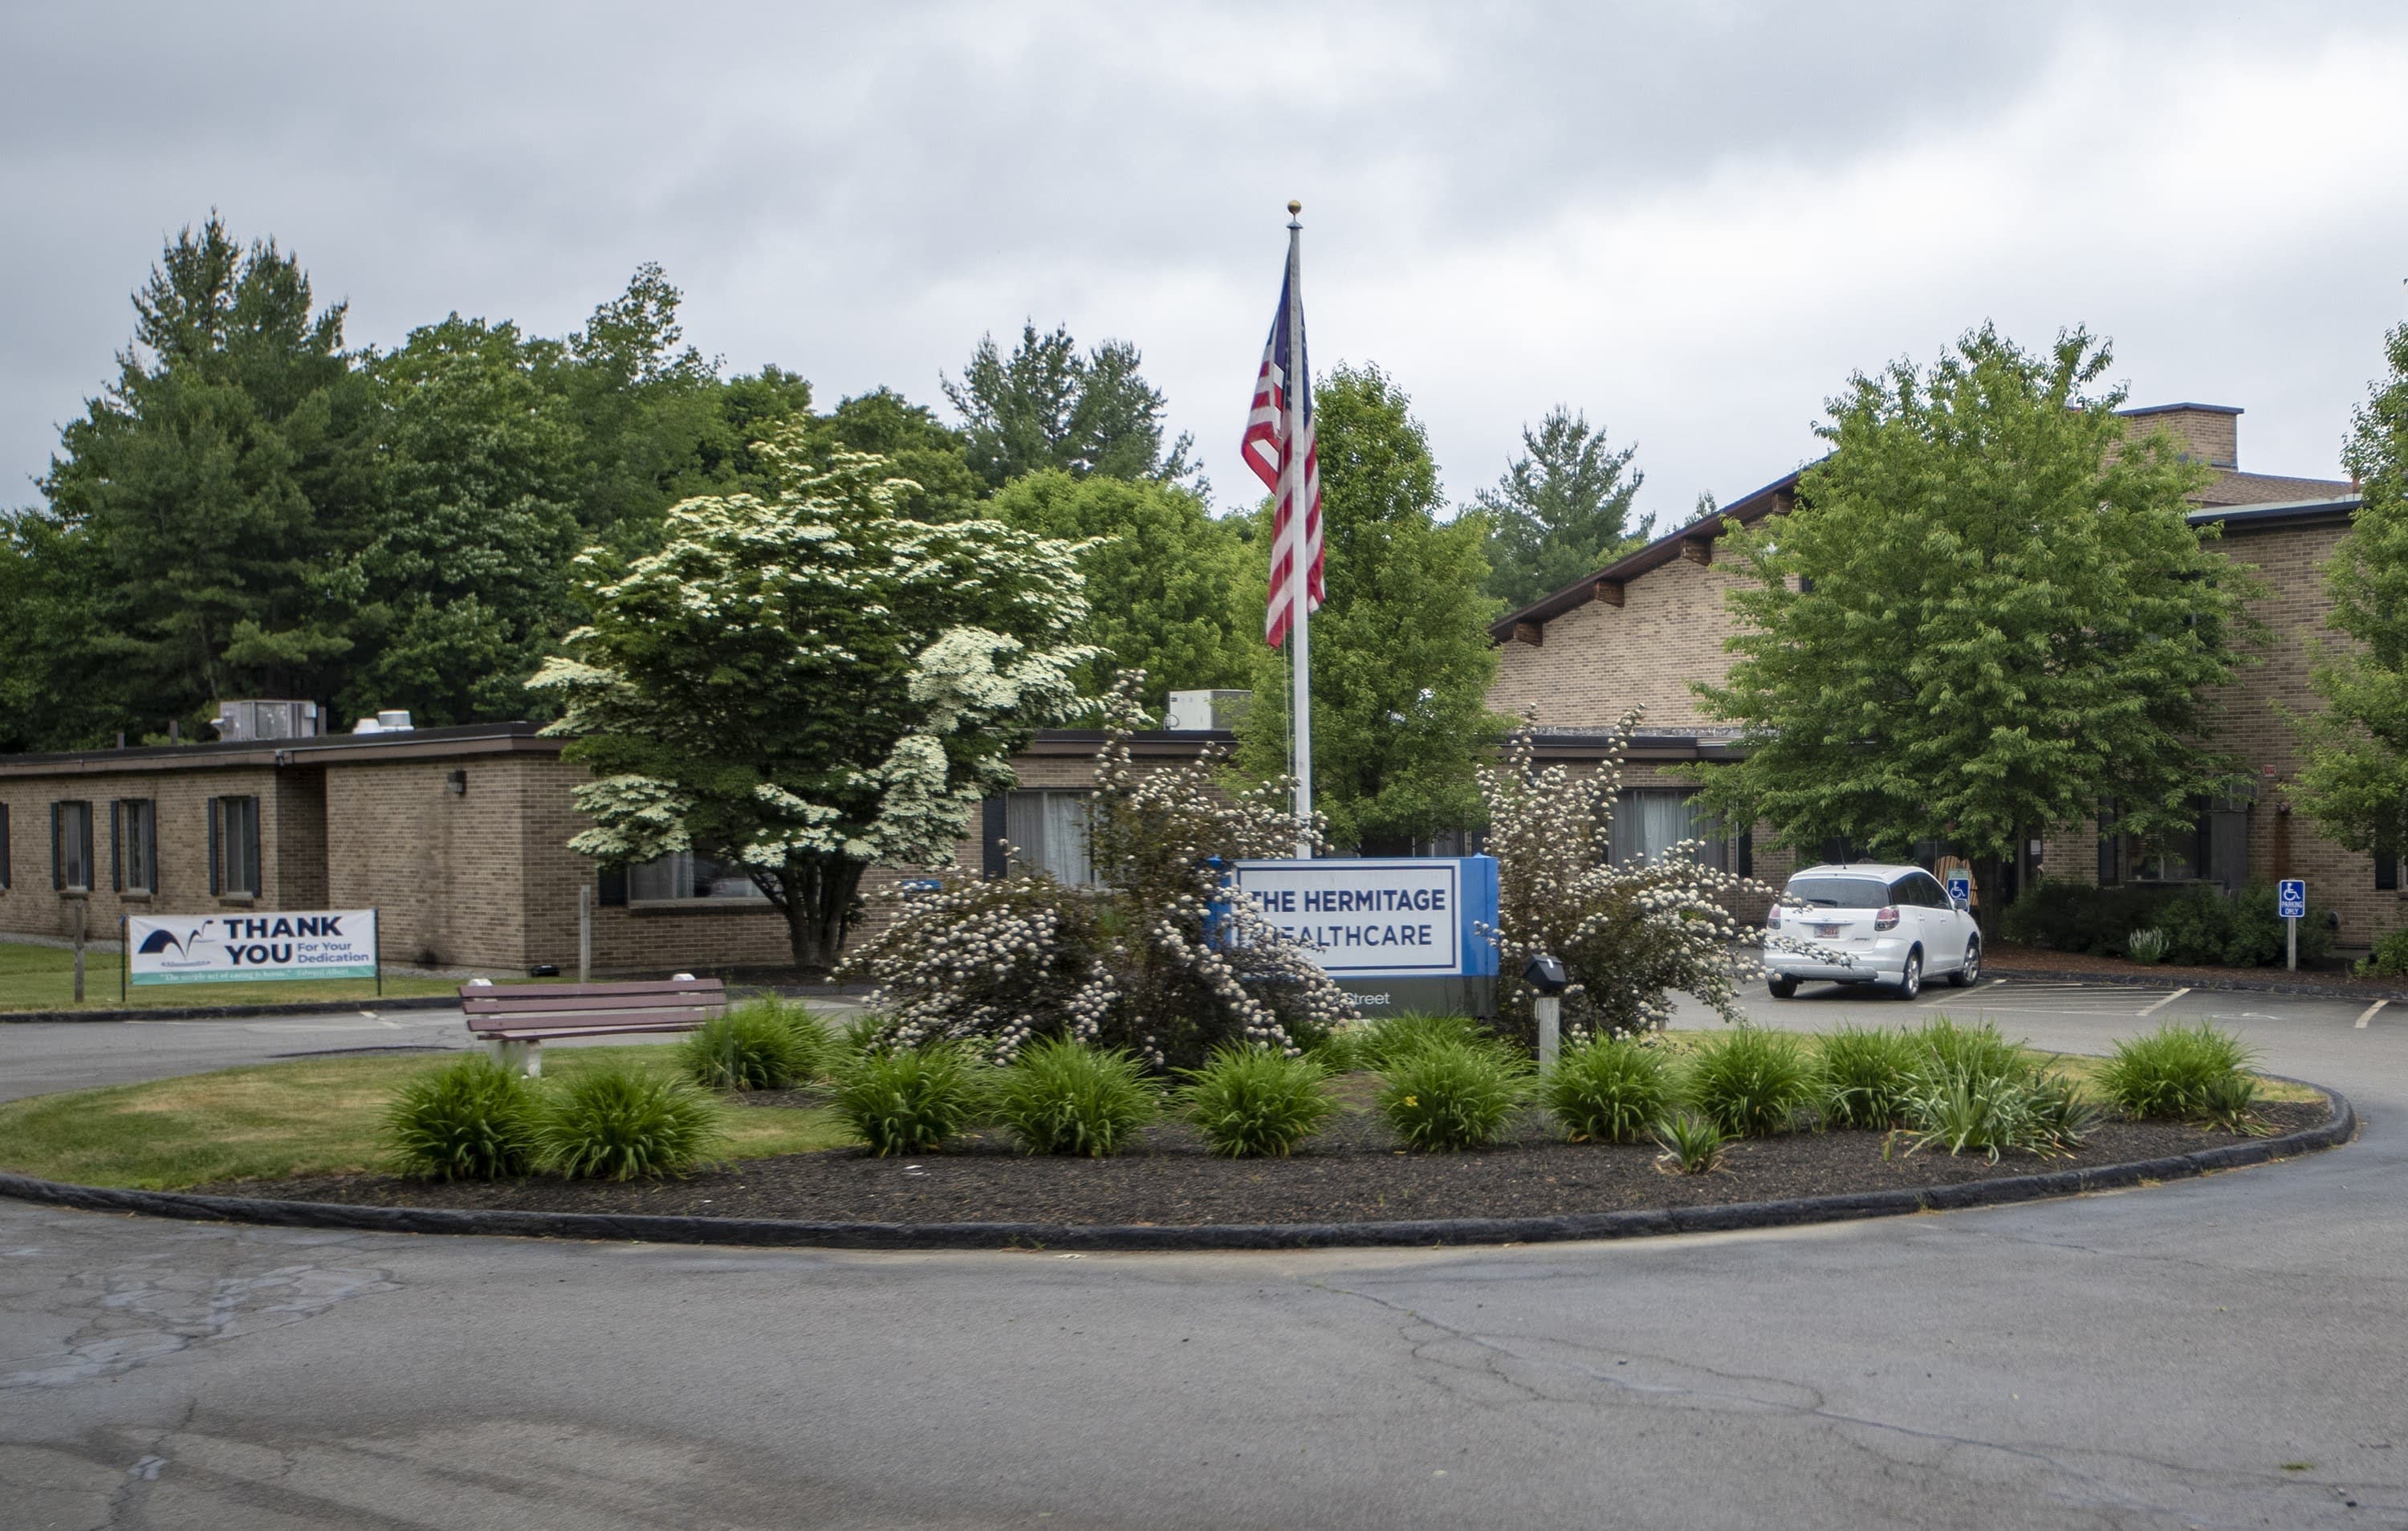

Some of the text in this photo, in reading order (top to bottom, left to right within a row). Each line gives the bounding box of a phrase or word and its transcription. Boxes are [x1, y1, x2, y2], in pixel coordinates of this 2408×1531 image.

[1305, 890, 1446, 912] HERMITAGE
[223, 914, 343, 939] THANK
[225, 943, 293, 965] YOU
[297, 942, 352, 952] For Your
[298, 952, 370, 963] Dedication
[1346, 992, 1391, 1005] Street
